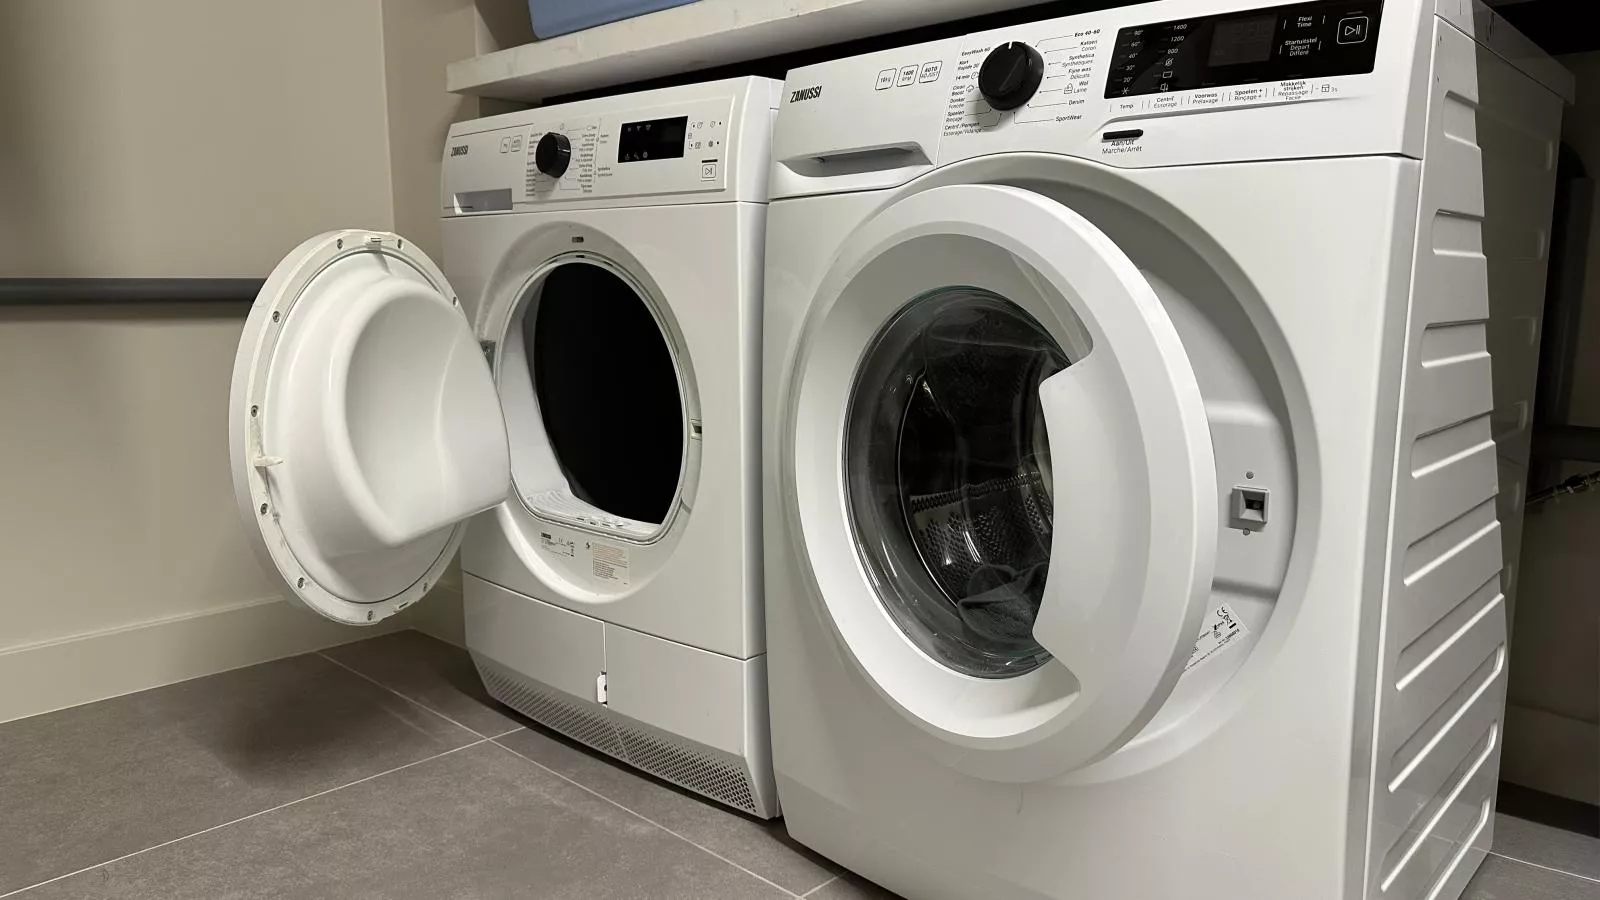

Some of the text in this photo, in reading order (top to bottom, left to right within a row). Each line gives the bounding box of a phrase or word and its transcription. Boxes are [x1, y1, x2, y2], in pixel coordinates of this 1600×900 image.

[1284, 37, 1317, 45] Startuitstel
[789, 85, 823, 104] ZANUSSI
[1234, 88, 1258, 96] Spoelen
[1110, 139, 1135, 147] Aan/Uit
[450, 145, 469, 157] ZANUSSI
[1102, 146, 1142, 154] Marche/Arrêt
